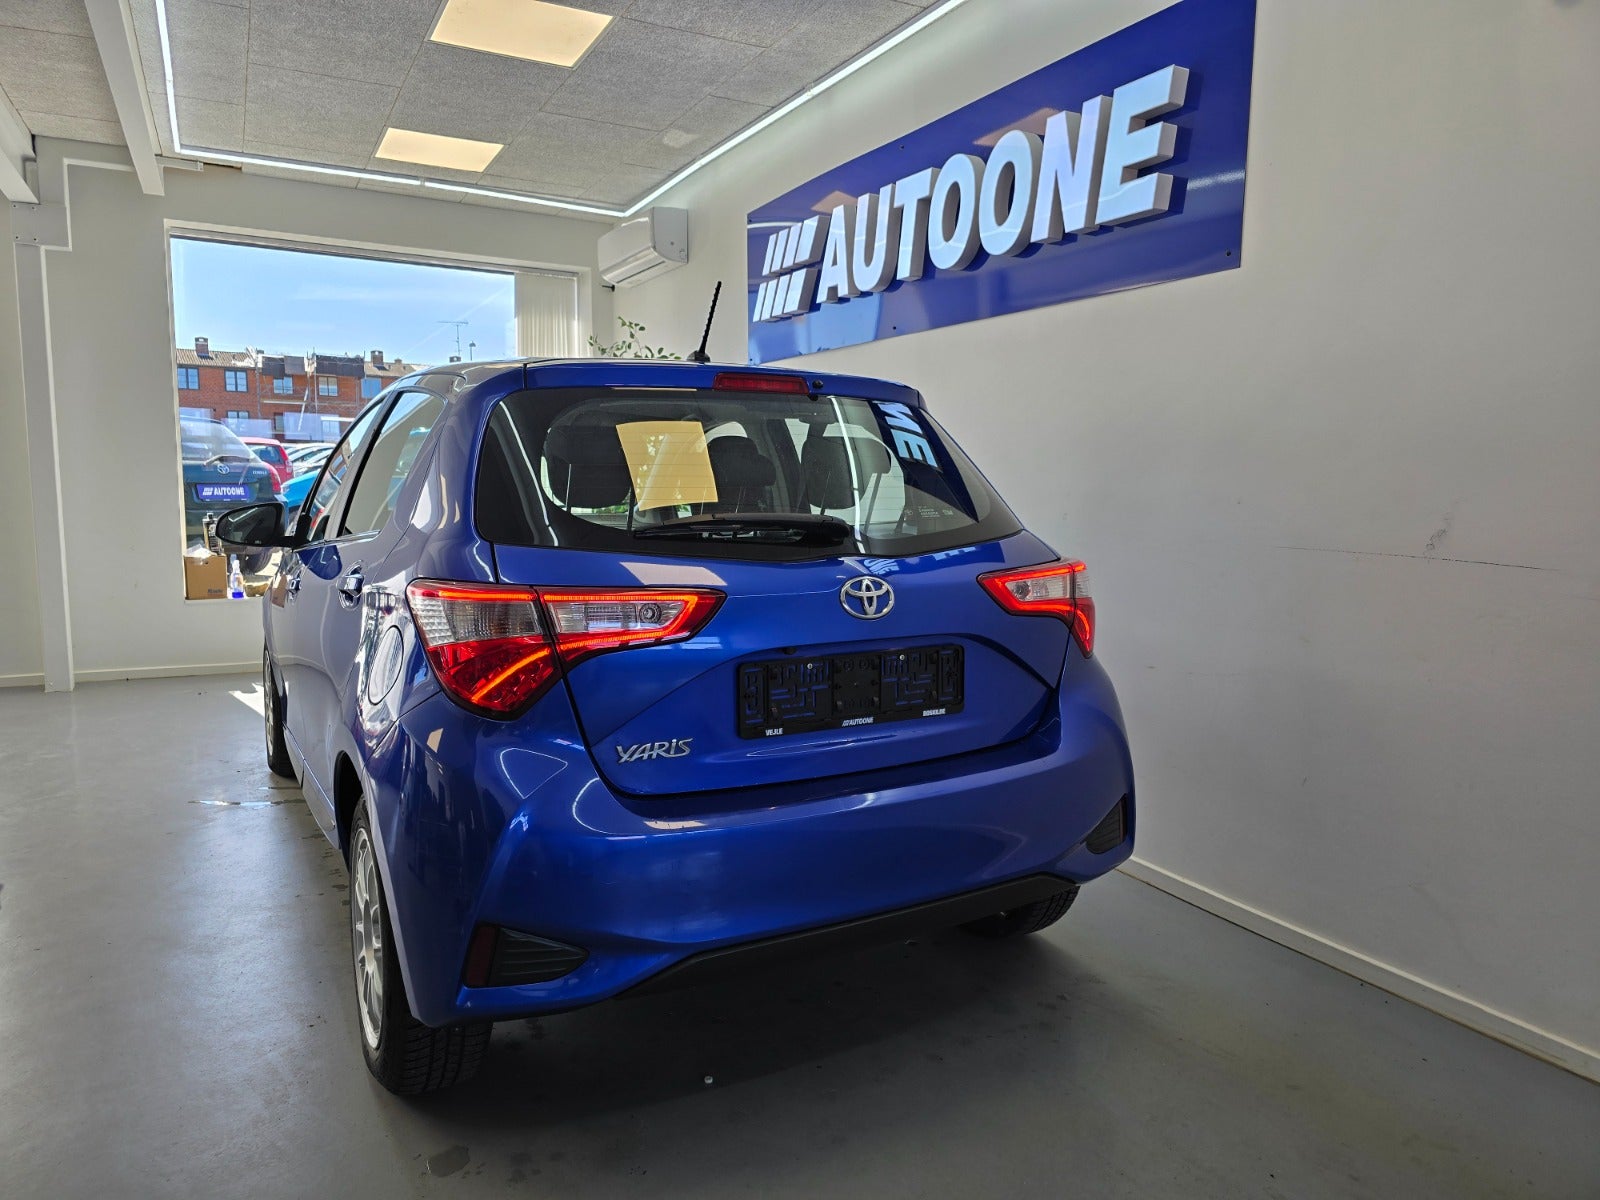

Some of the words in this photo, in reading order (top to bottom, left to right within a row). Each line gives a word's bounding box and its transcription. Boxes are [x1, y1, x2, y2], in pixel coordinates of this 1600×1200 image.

[816, 64, 1190, 304] AUTOONE
[213, 486, 245, 496] AUTOONE
[848, 716, 874, 727] AUTOONE
[765, 727, 784, 737] VEJLE
